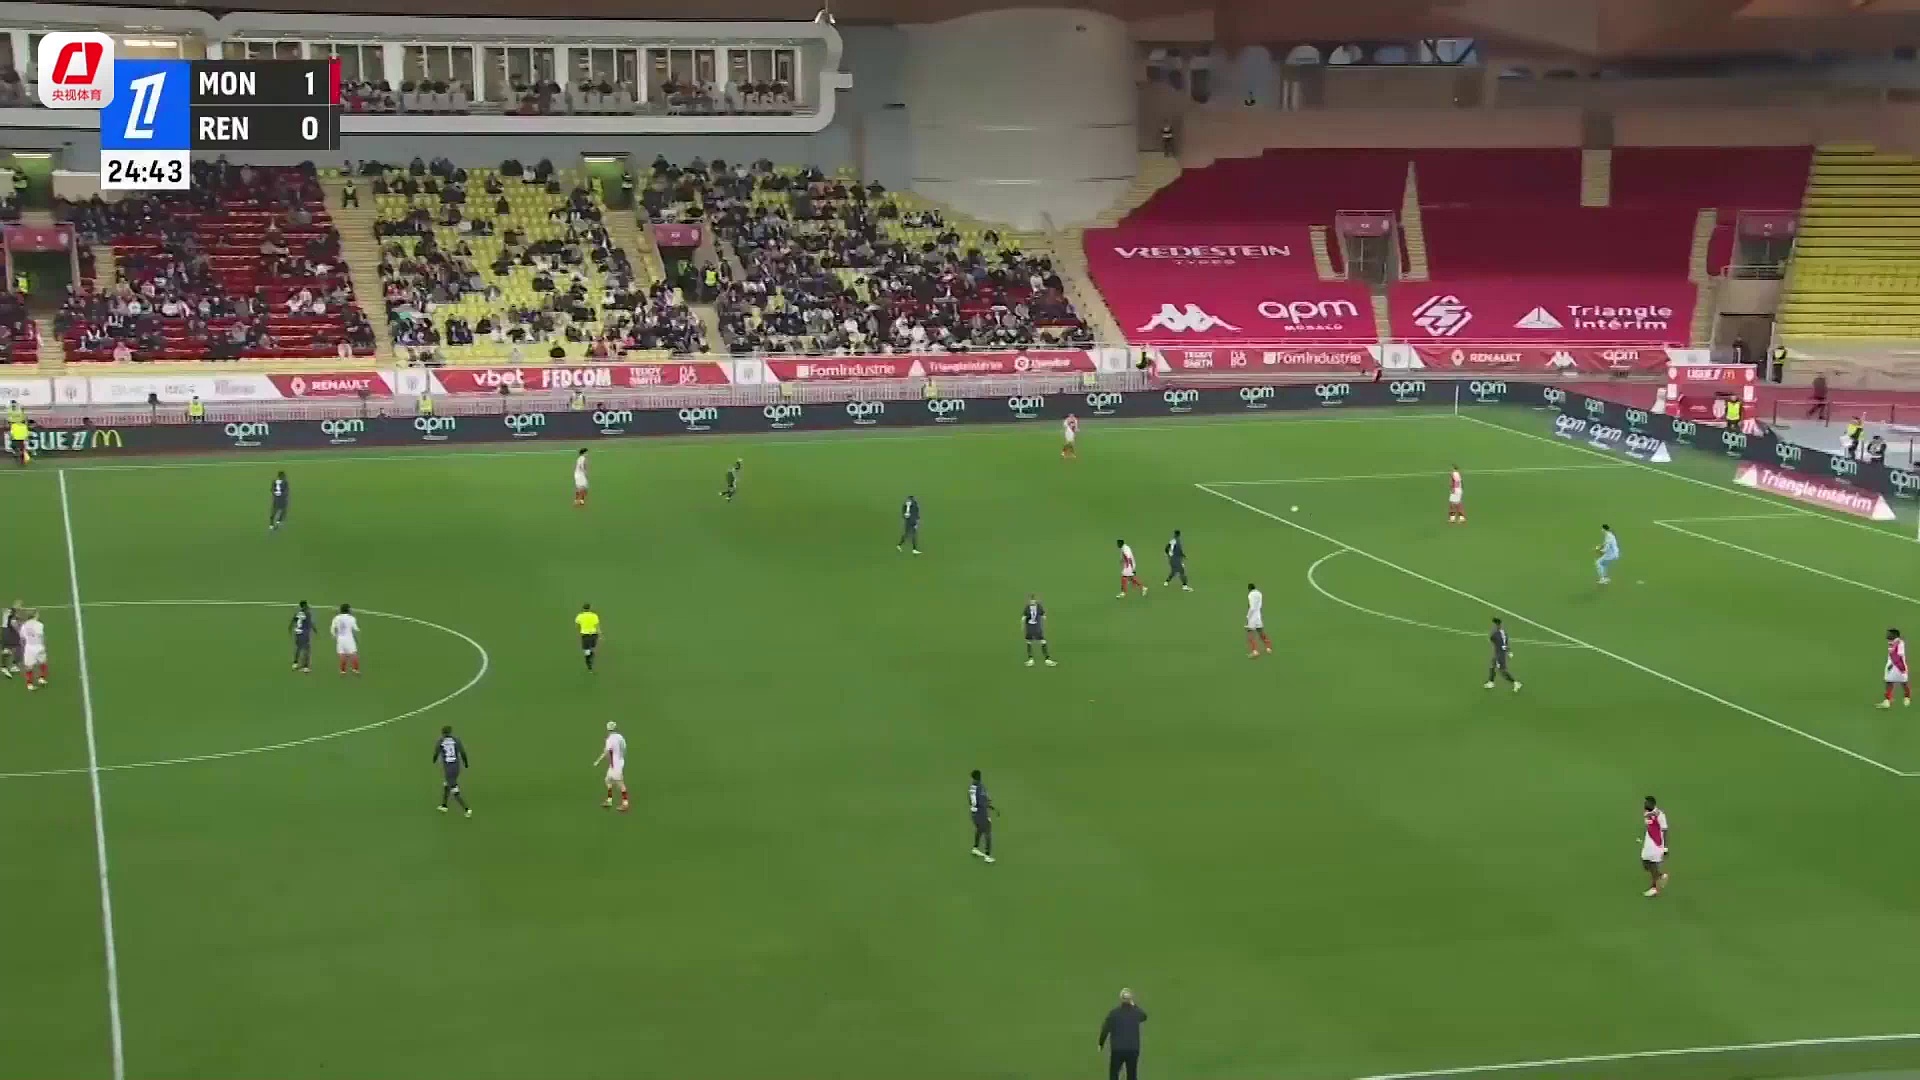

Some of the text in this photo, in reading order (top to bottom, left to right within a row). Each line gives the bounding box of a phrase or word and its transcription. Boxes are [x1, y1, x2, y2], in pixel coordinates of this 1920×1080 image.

[1113, 244, 1291, 260] VREDESTEIN
[1256, 299, 1359, 324] apm
[1567, 304, 1674, 319] Triangle
[1469, 352, 1523, 363] RENAULT
[311, 378, 372, 392] RENAULT
[472, 369, 524, 386] vbet
[541, 369, 612, 388] FEDCOM
[1239, 386, 1275, 404] apm
[1315, 383, 1350, 401] apm
[1390, 380, 1426, 398] apm
[1470, 380, 1507, 397] apm
[1008, 395, 1045, 413] apm
[1087, 392, 1123, 411] apm
[1163, 389, 1199, 407] apm
[678, 407, 718, 425] apm
[763, 404, 802, 422] apm
[846, 401, 885, 418] apm
[927, 399, 966, 416] apm
[321, 418, 365, 435] apm
[415, 416, 456, 435] apm
[504, 413, 546, 431] apm
[592, 410, 634, 428] apm
[225, 421, 270, 438] apm
[1761, 469, 1816, 498] Triangle
